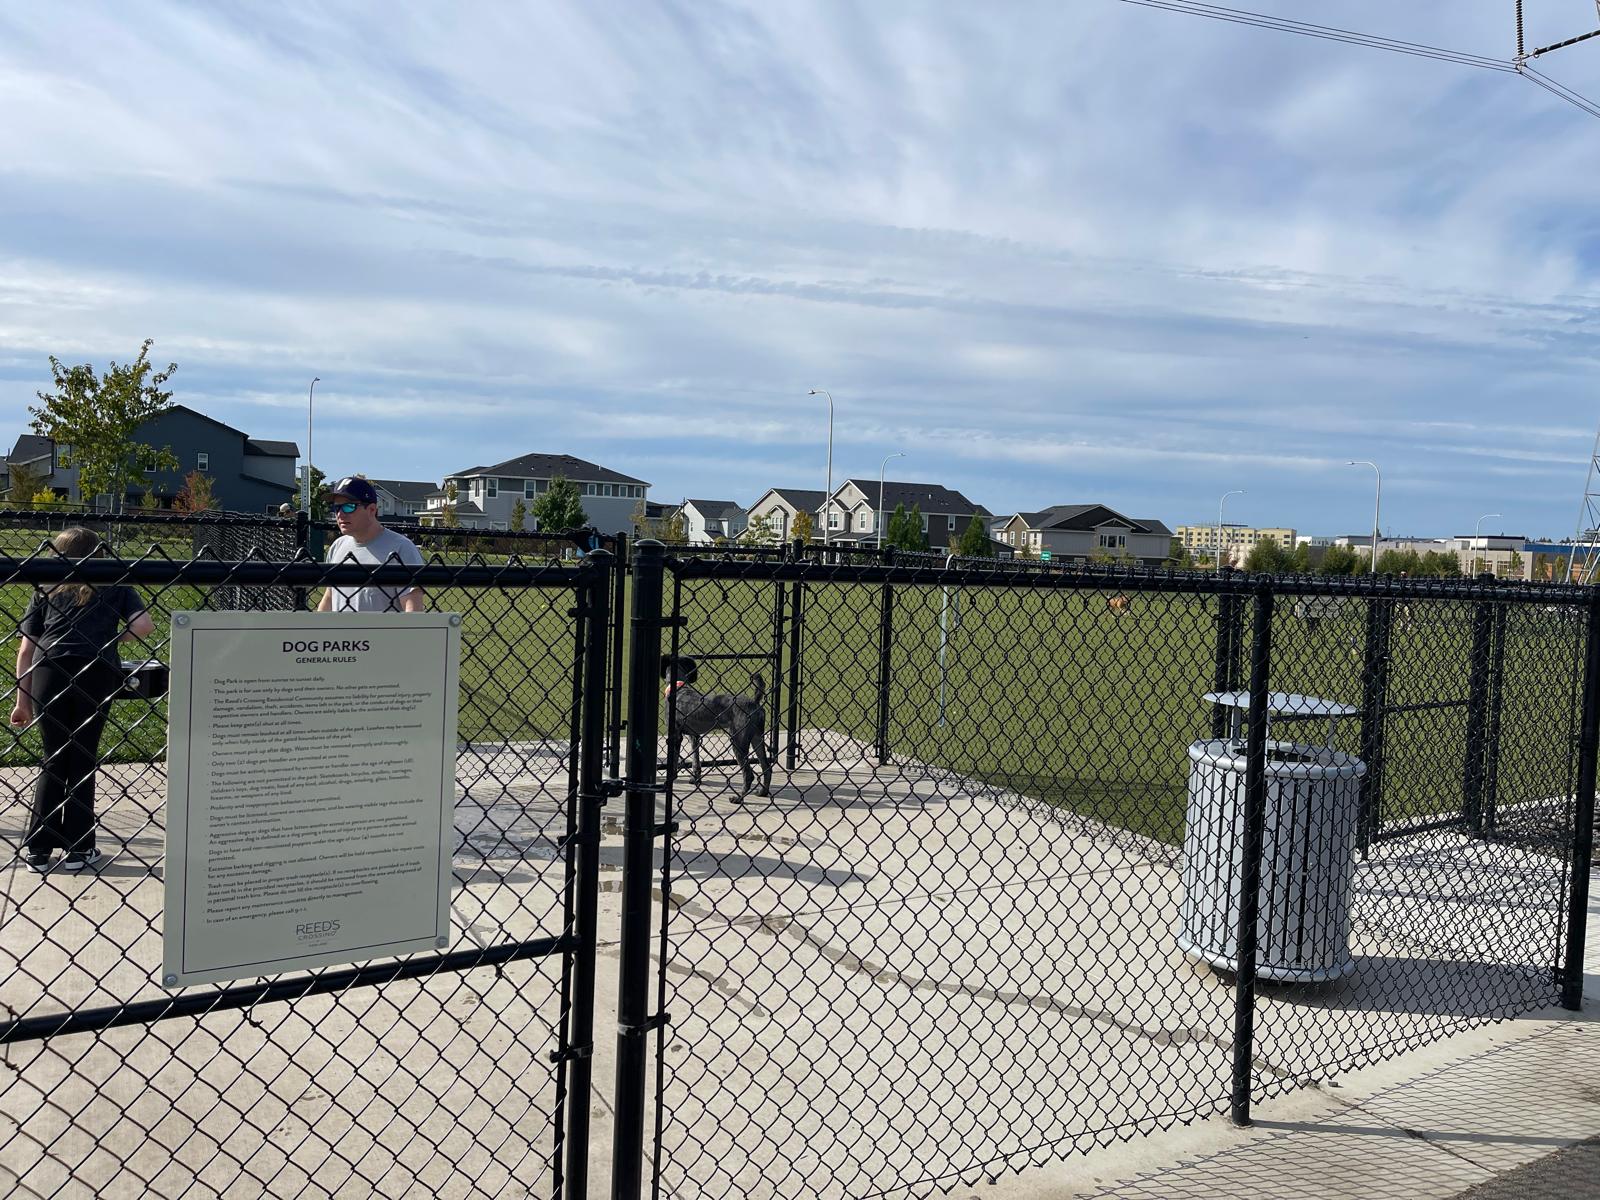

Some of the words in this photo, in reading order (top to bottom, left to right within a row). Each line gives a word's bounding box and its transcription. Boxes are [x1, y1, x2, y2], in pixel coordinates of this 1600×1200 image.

[282, 641, 319, 653] DOG
[322, 640, 370, 652] PARKS
[295, 656, 332, 664] GENERAL
